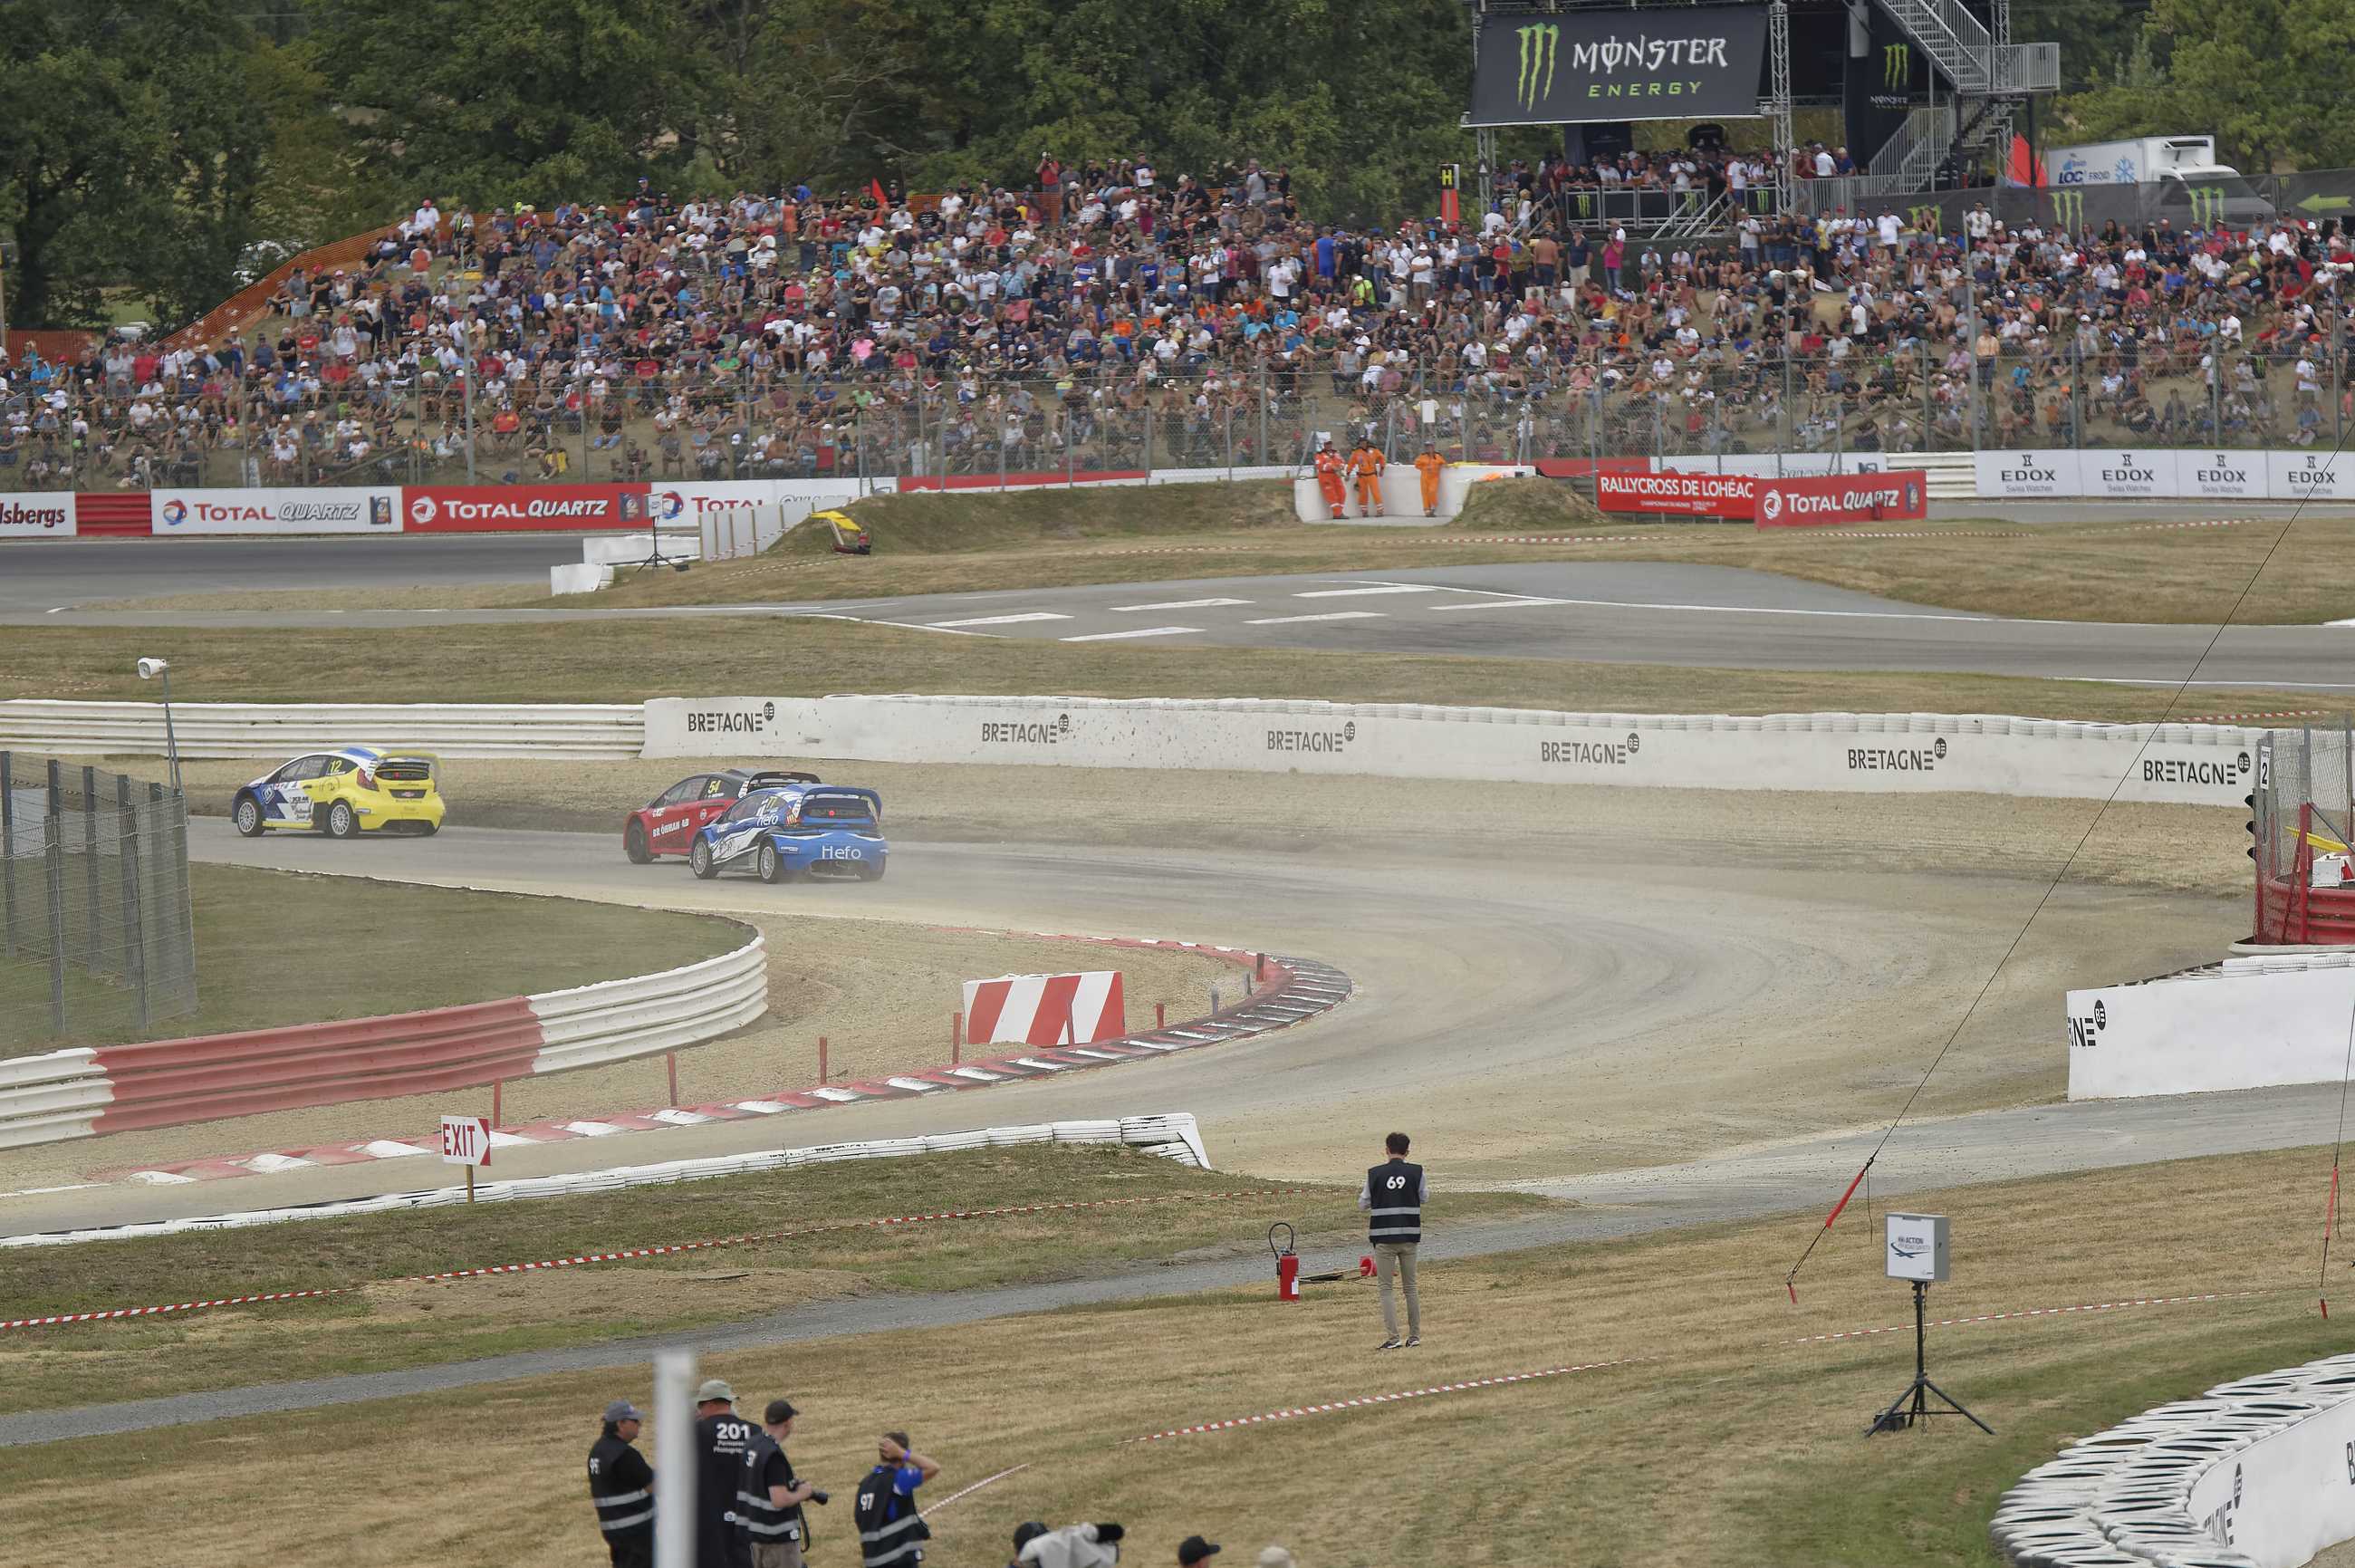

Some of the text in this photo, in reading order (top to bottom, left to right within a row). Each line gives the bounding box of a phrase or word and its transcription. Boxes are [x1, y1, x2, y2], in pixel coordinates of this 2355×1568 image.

[1572, 34, 1728, 74] MONSTER
[1588, 82, 1702, 97] ENERGY
[1442, 168, 1452, 186] H
[2001, 469, 2056, 482] EDOX
[2102, 469, 2154, 482] EDOX
[2197, 469, 2246, 483] EDOX
[2288, 471, 2336, 484] EDOX
[1600, 476, 1754, 498] RALLYCROSS DE LOHÉAC
[194, 502, 360, 522] TOTAL QUARTZ
[443, 499, 608, 519] TOTAL QUARTZ
[1786, 493, 1841, 513] TOTAL
[688, 712, 763, 732] BRETAGNE
[982, 724, 1057, 743] BRETAGNE
[1268, 730, 1342, 752] BRETAGNE
[1542, 741, 1626, 764] BRETAGNE
[1848, 749, 1934, 770] BRETAGNE
[330, 760, 342, 773] 12
[2143, 760, 2236, 784] BRETAGNE
[2261, 763, 2268, 784] 2
[707, 780, 721, 794] 54
[822, 845, 861, 860] Hefo
[442, 1123, 476, 1158] EXIT
[1386, 1176, 1406, 1189] 69
[716, 1423, 751, 1439] 201
[860, 1493, 875, 1511] 97
